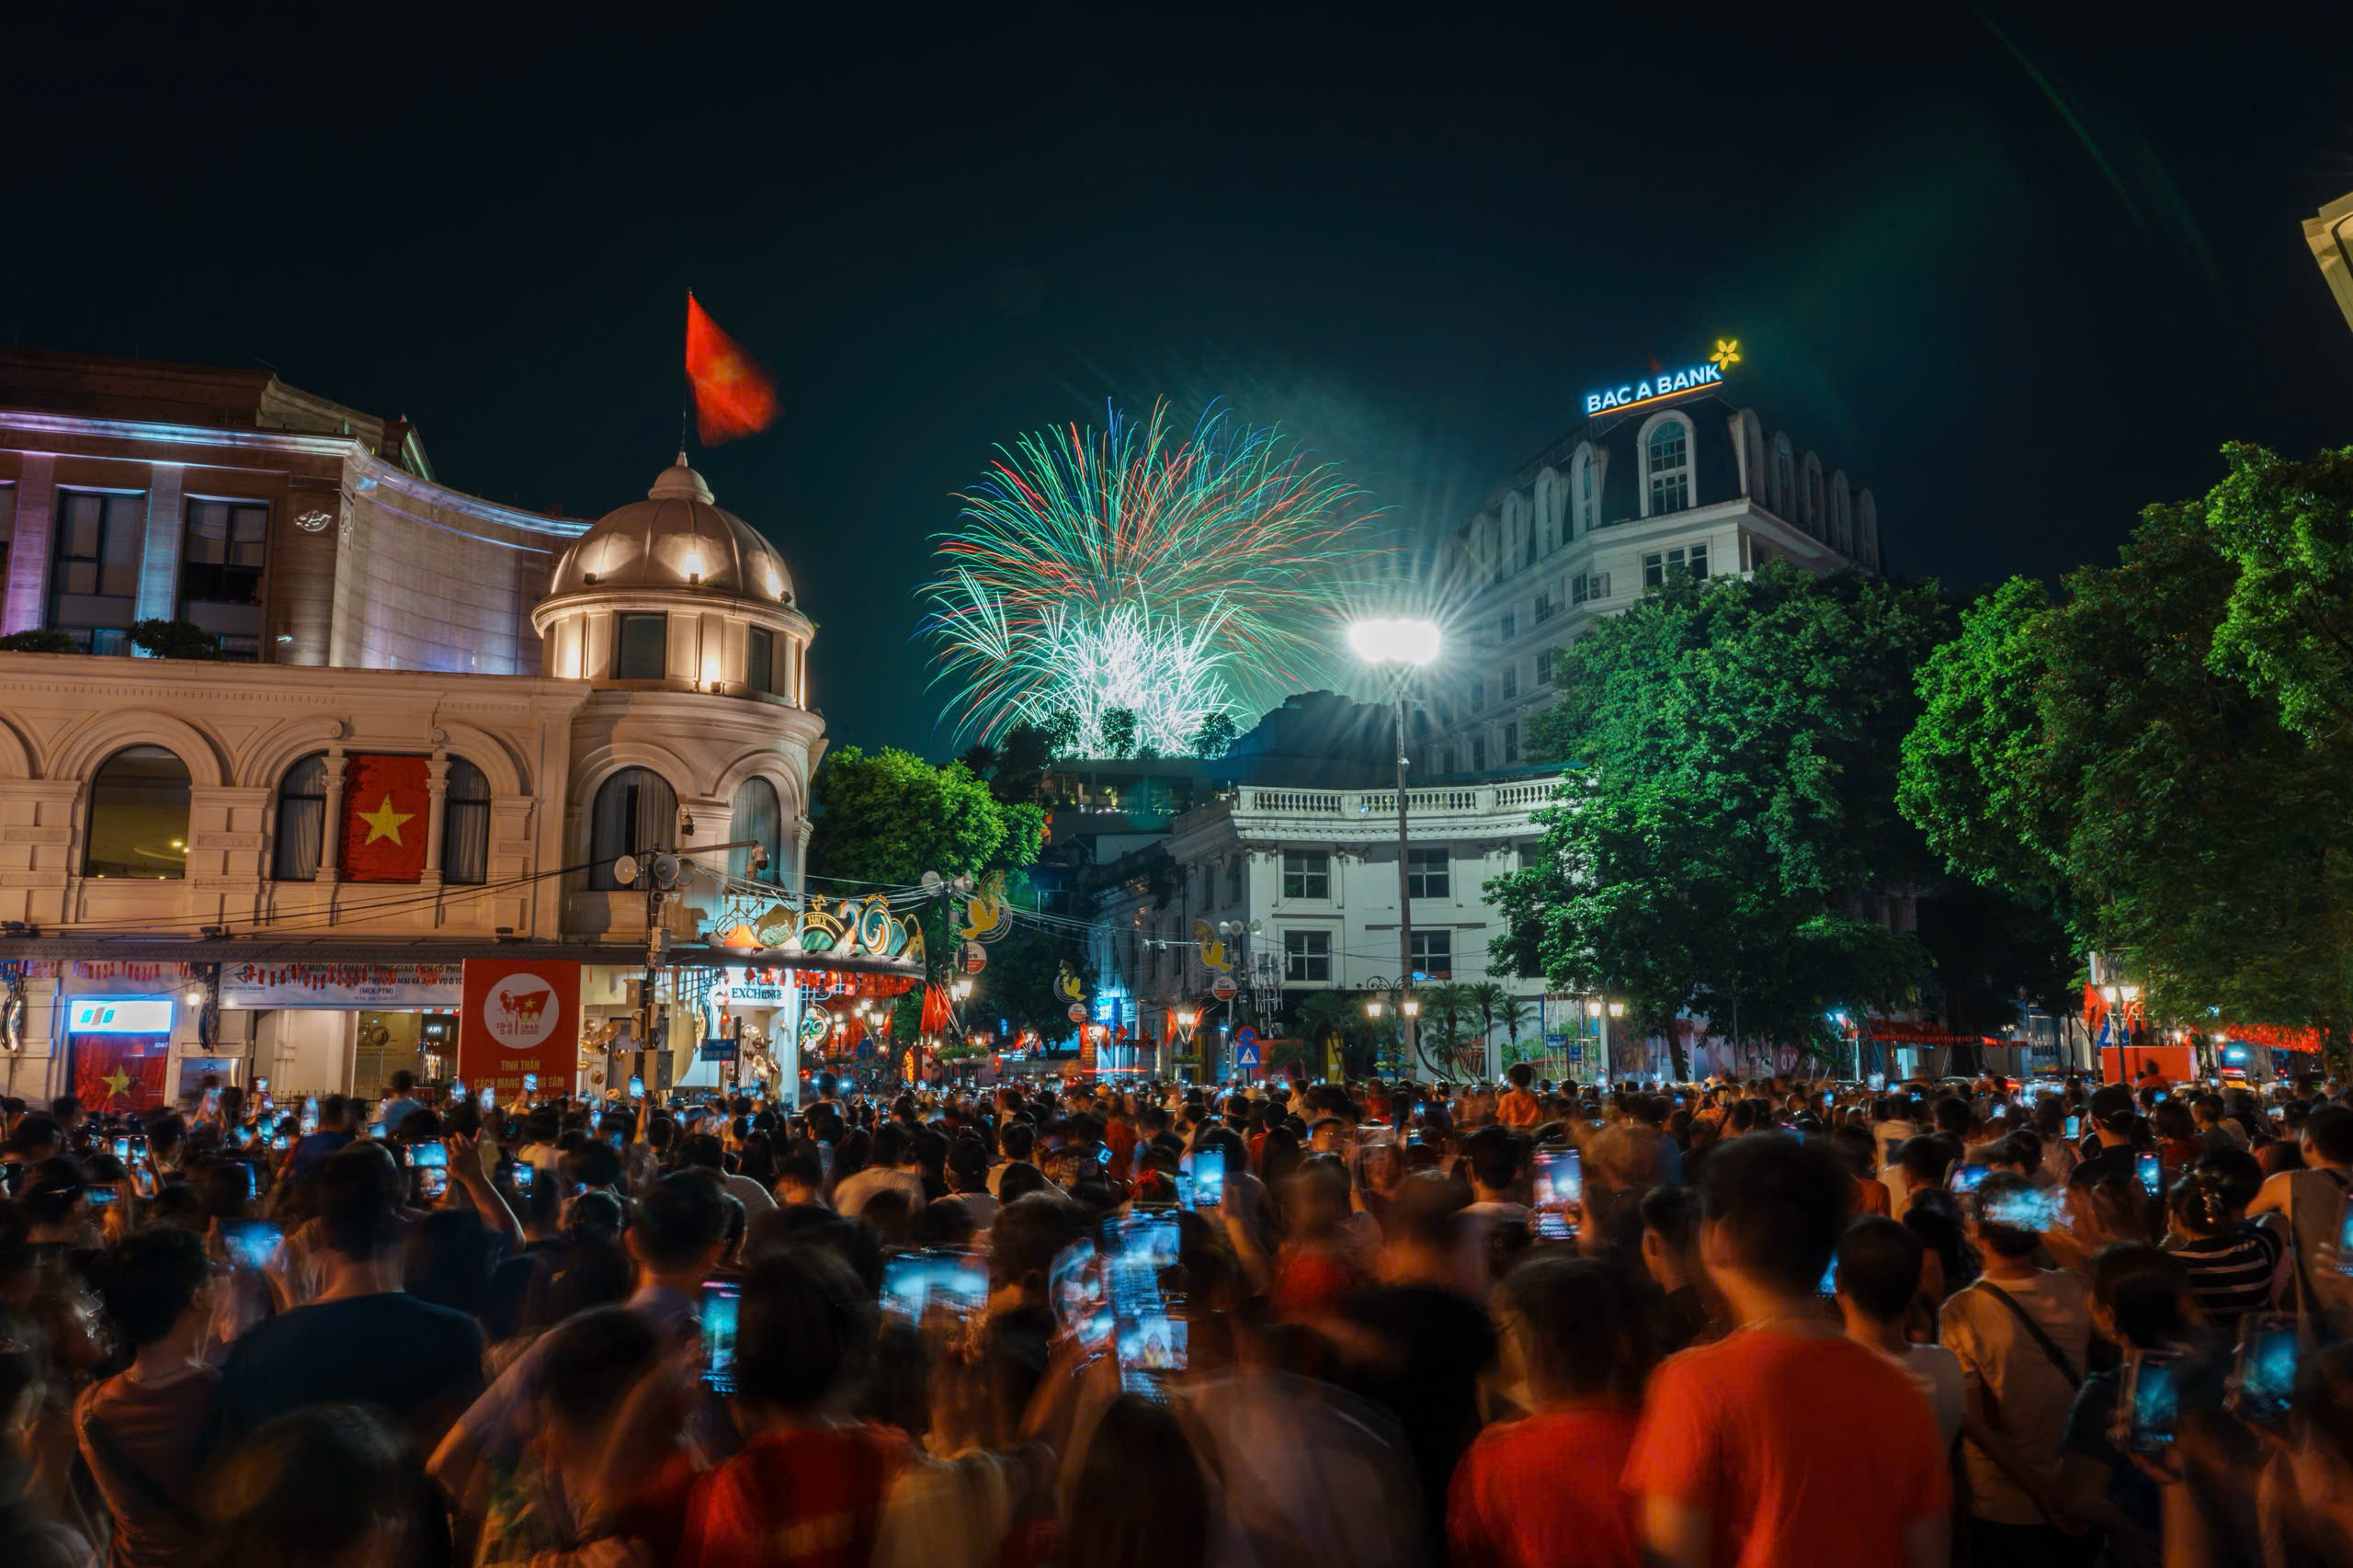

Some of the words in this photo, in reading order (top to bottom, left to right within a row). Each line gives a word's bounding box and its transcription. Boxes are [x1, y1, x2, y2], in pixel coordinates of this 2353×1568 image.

[1587, 387, 1631, 413] BAC
[1636, 382, 1653, 400] A
[1657, 363, 1722, 394] BANK
[501, 1060, 518, 1071] TINH
